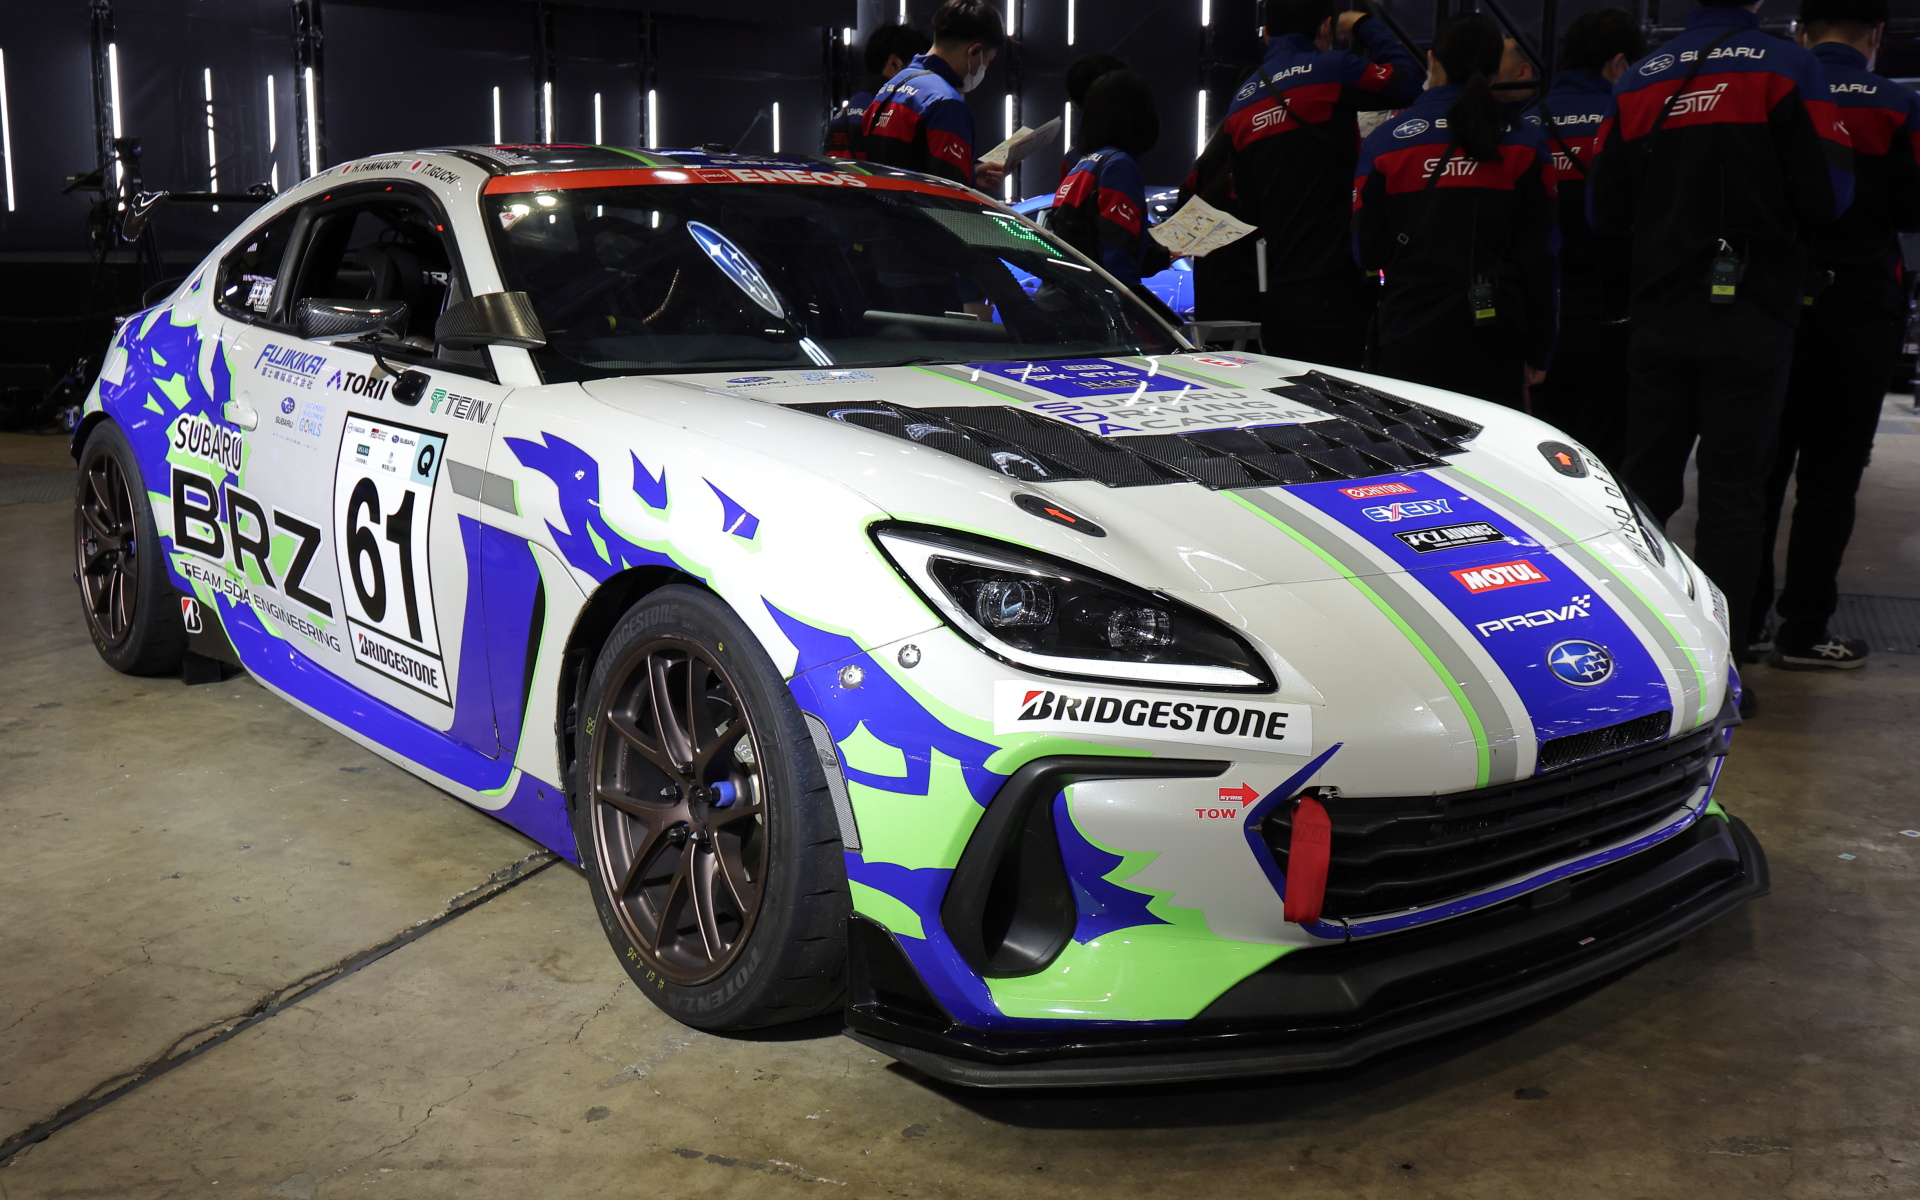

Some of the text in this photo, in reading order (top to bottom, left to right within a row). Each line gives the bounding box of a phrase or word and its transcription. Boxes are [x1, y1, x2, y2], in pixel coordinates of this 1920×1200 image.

[728, 168, 868, 188] ENEOS
[254, 343, 328, 376] FUJIKIKAI
[342, 371, 390, 401] TORII
[274, 415, 294, 429] SUBARU
[445, 392, 493, 424] TEIN
[173, 416, 243, 472] SUBARU
[417, 444, 435, 478] Q
[1363, 482, 1411, 496] CHIYODA
[1362, 498, 1454, 522] EXEDY
[171, 467, 334, 620] BRZ
[1441, 522, 1499, 541] ADVANCE
[346, 476, 424, 644] 61
[1460, 563, 1543, 591] MOTUL
[179, 561, 342, 653] TEAM SDA ENGINEERING
[1474, 603, 1591, 638] PROVA
[357, 633, 438, 690] BRIDGESTONE
[1017, 690, 1290, 741] BRIDGESTONE
[1194, 808, 1237, 820] TOW
[668, 946, 763, 1013] POTENZA
